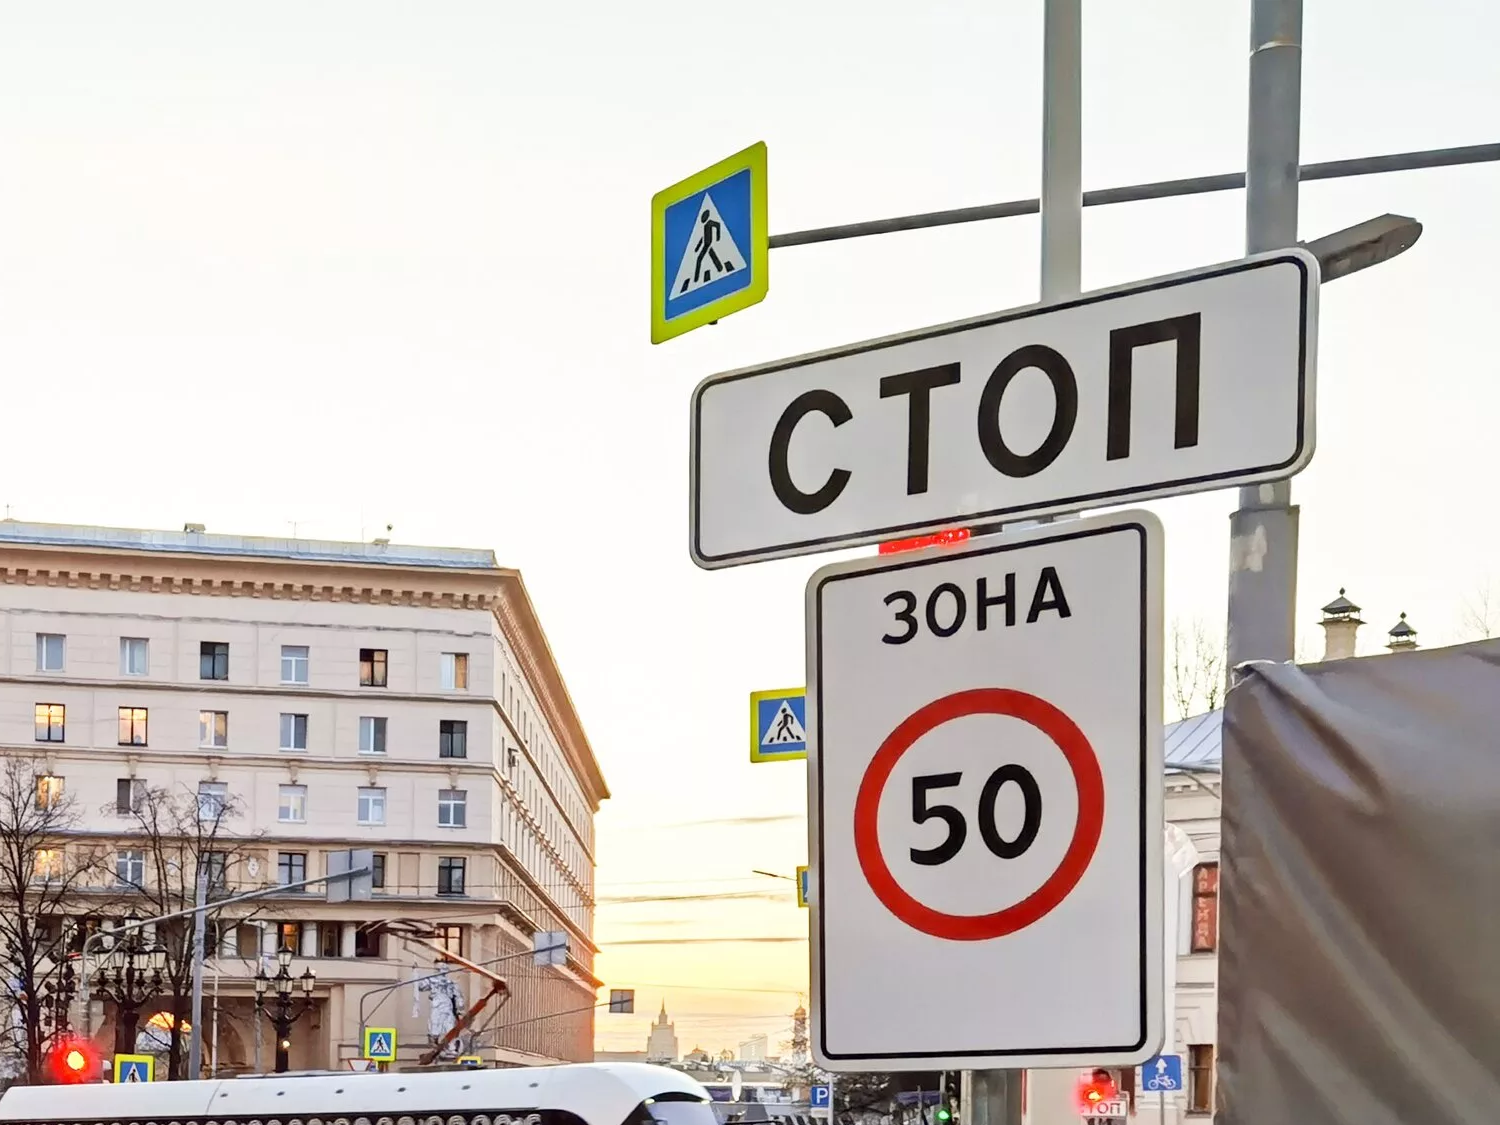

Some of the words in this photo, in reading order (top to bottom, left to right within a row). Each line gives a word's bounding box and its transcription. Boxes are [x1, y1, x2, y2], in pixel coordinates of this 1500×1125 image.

[768, 312, 1202, 514] СТОП
[881, 566, 1072, 645] ЗОНА
[910, 764, 1043, 866] 50
[816, 1087, 828, 1104] P
